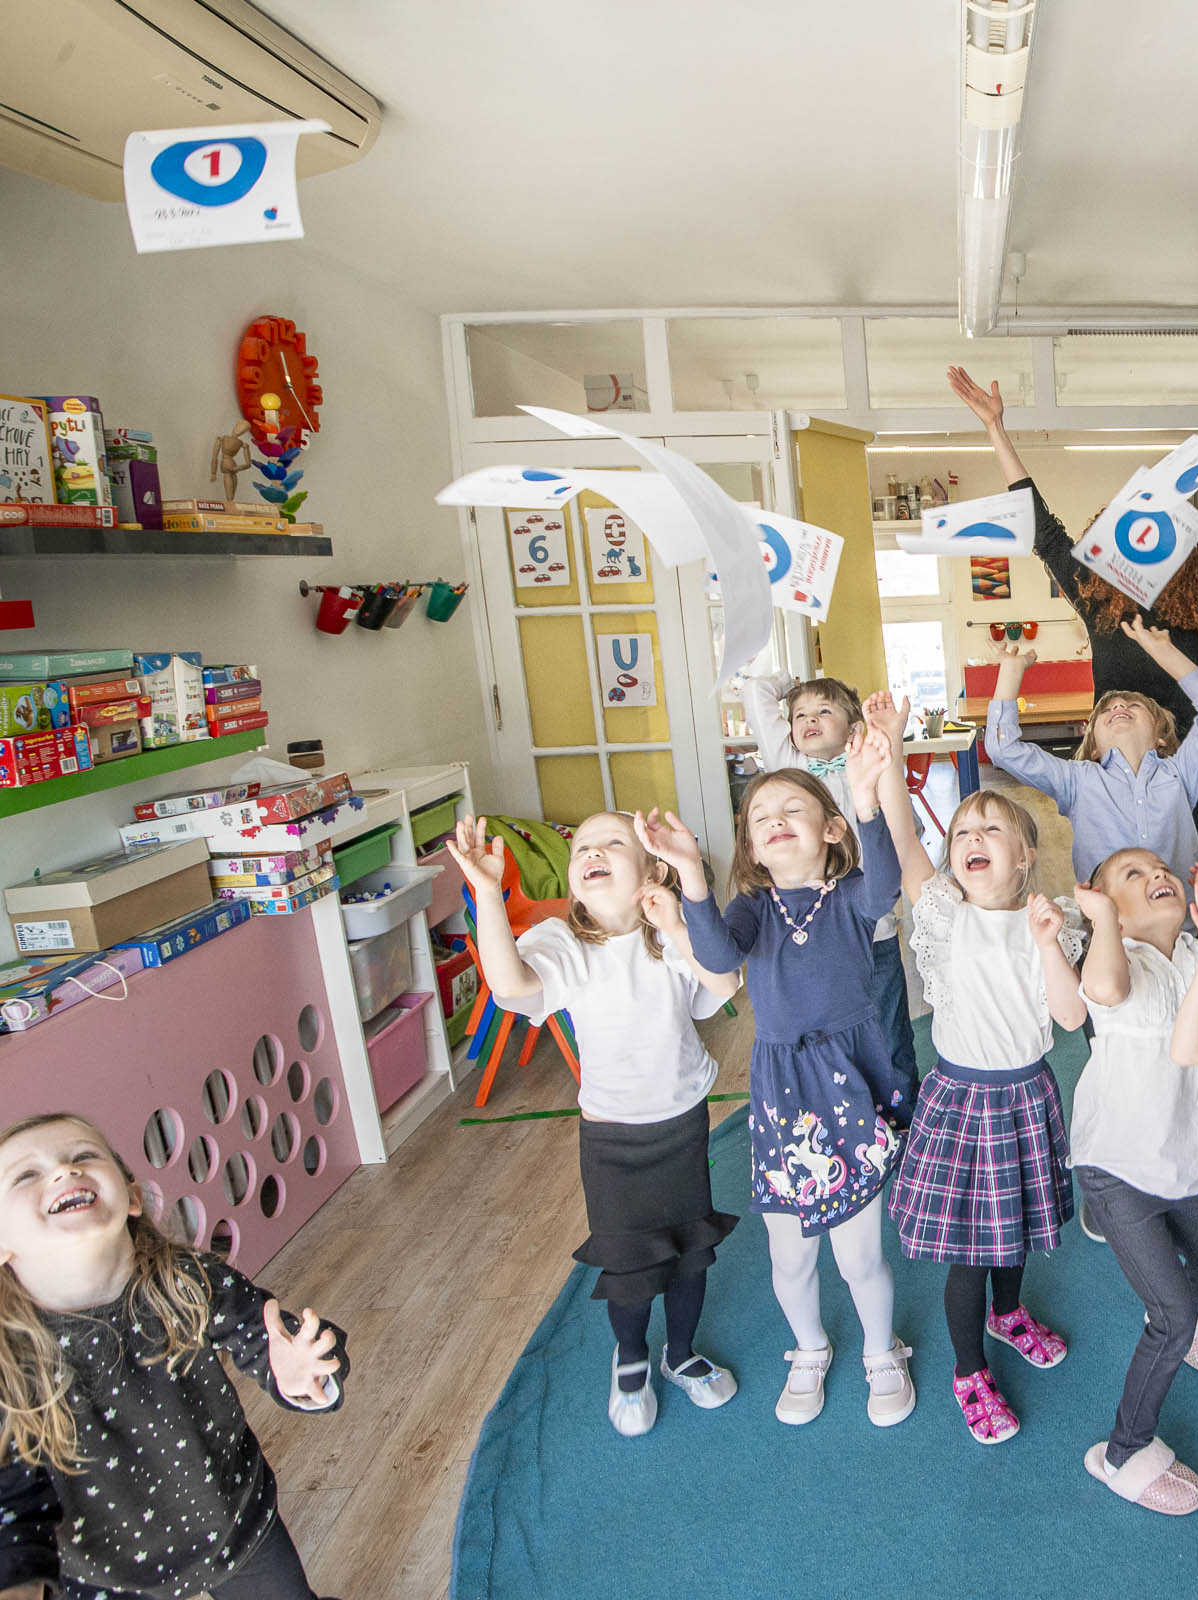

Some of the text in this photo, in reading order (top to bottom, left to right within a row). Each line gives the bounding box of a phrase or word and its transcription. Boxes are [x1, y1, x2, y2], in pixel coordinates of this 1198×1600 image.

[202, 149, 221, 178] 1
[300, 428, 312, 451] 5
[5, 447, 31, 467] HRY
[604, 514, 627, 547] C
[1136, 525, 1153, 545] 1
[528, 535, 549, 564] 6
[612, 638, 638, 671] U
[15, 924, 28, 951] CAMPER
